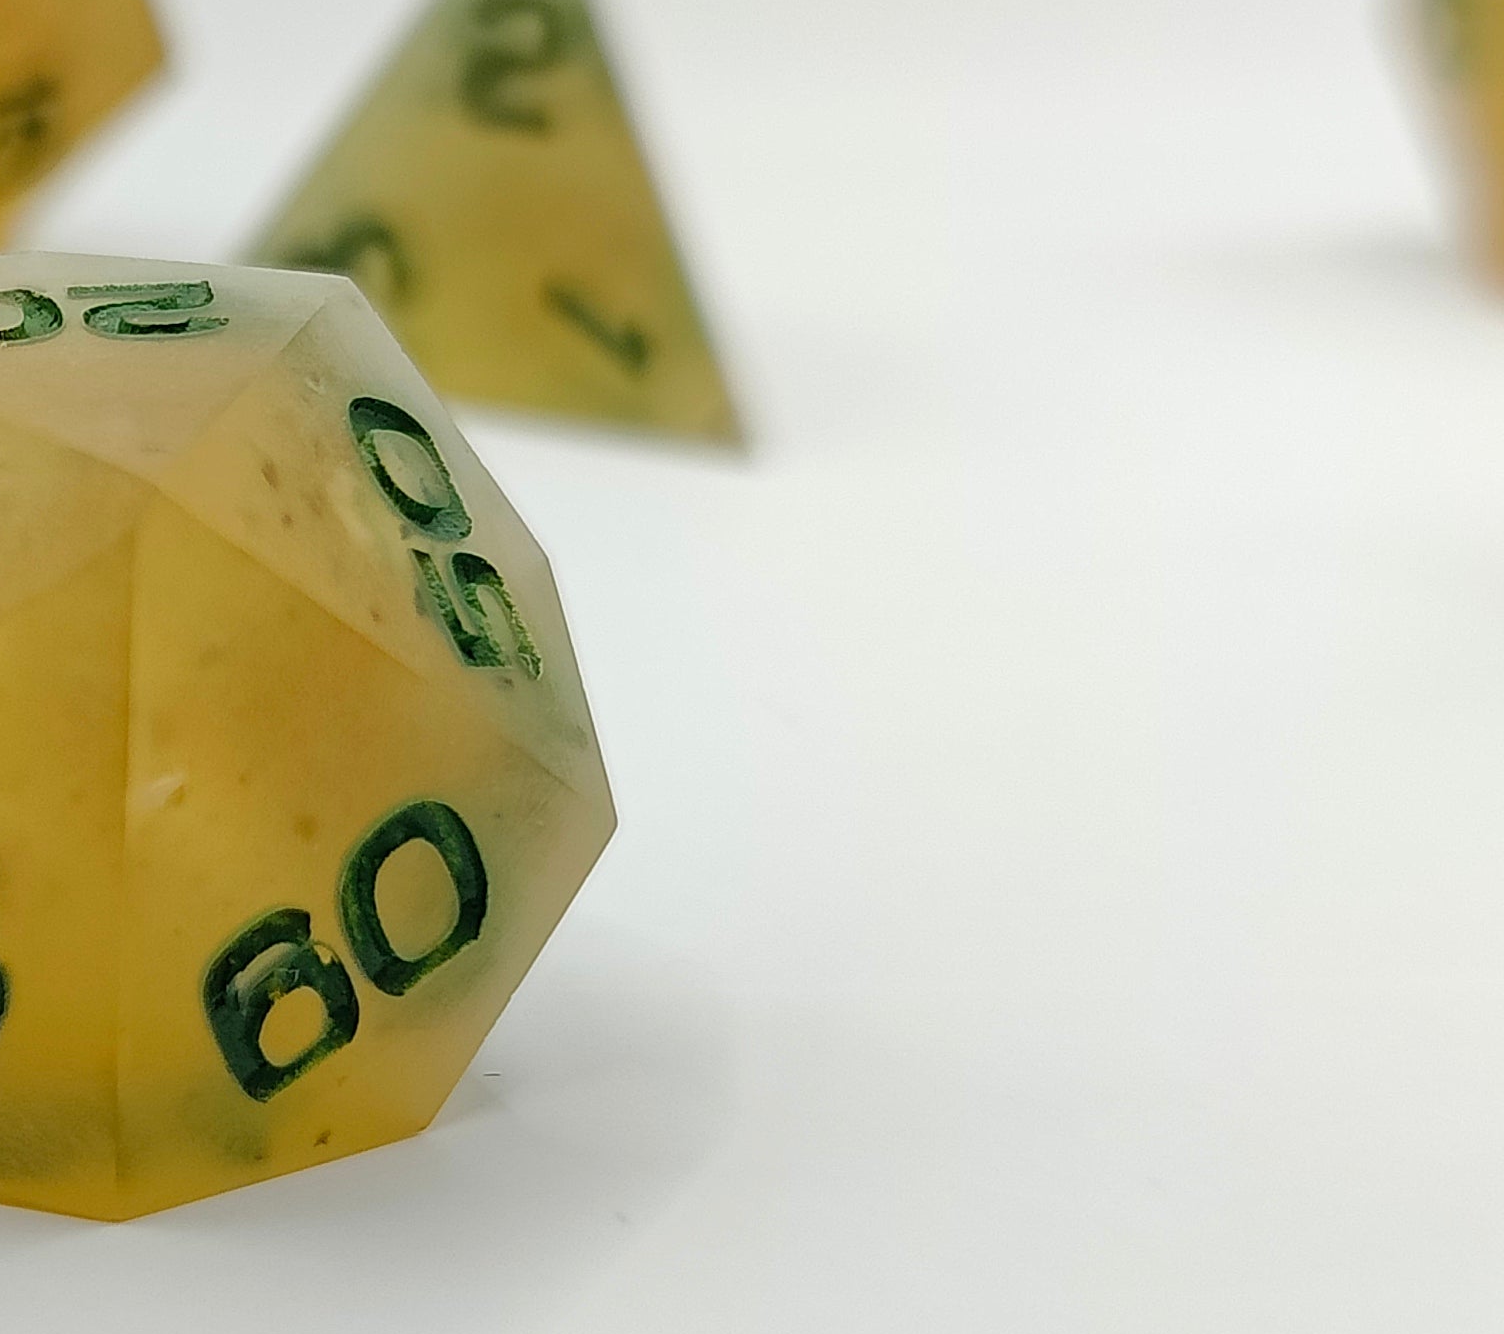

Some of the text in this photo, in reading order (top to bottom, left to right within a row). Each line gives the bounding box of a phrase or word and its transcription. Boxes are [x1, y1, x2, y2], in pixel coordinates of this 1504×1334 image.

[538, 278, 653, 377] 1
[349, 396, 543, 681] 50
[202, 799, 491, 1104] 60
